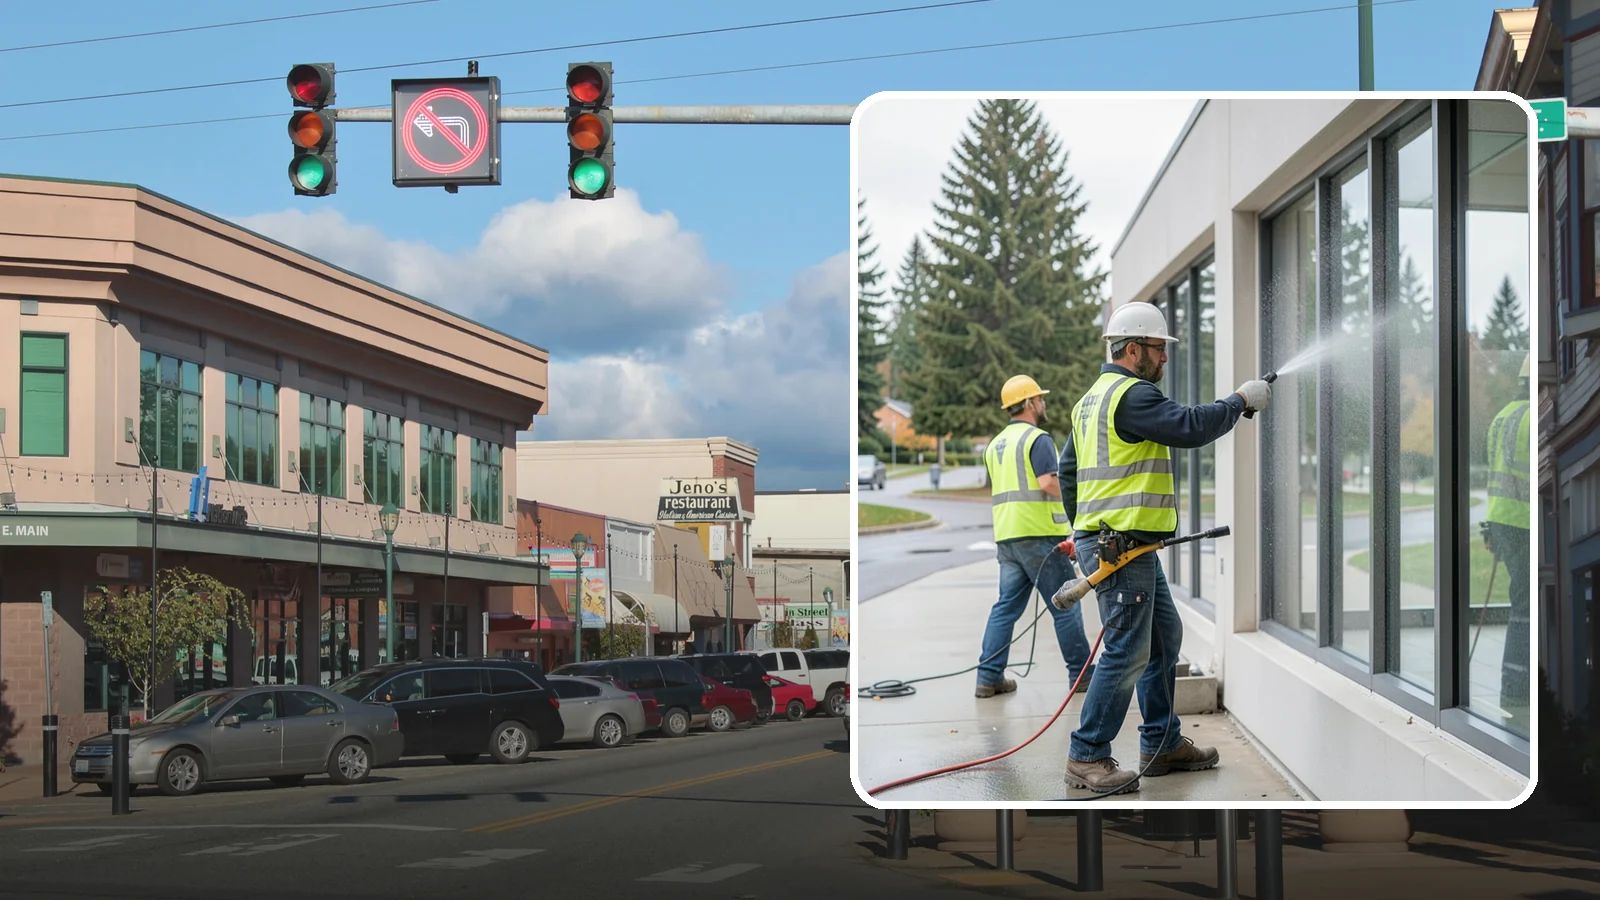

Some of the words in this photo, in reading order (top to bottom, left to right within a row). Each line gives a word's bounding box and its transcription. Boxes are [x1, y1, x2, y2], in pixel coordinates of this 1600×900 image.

[669, 480, 727, 494] Jeno's
[665, 496, 731, 509] restaurant
[658, 510, 681, 519] Italian
[686, 510, 714, 519] American
[715, 510, 738, 519] Cuisine
[2, 525, 13, 536] E.
[15, 525, 49, 536] MAIN
[797, 607, 829, 617] Street
[790, 619, 824, 627] lass
